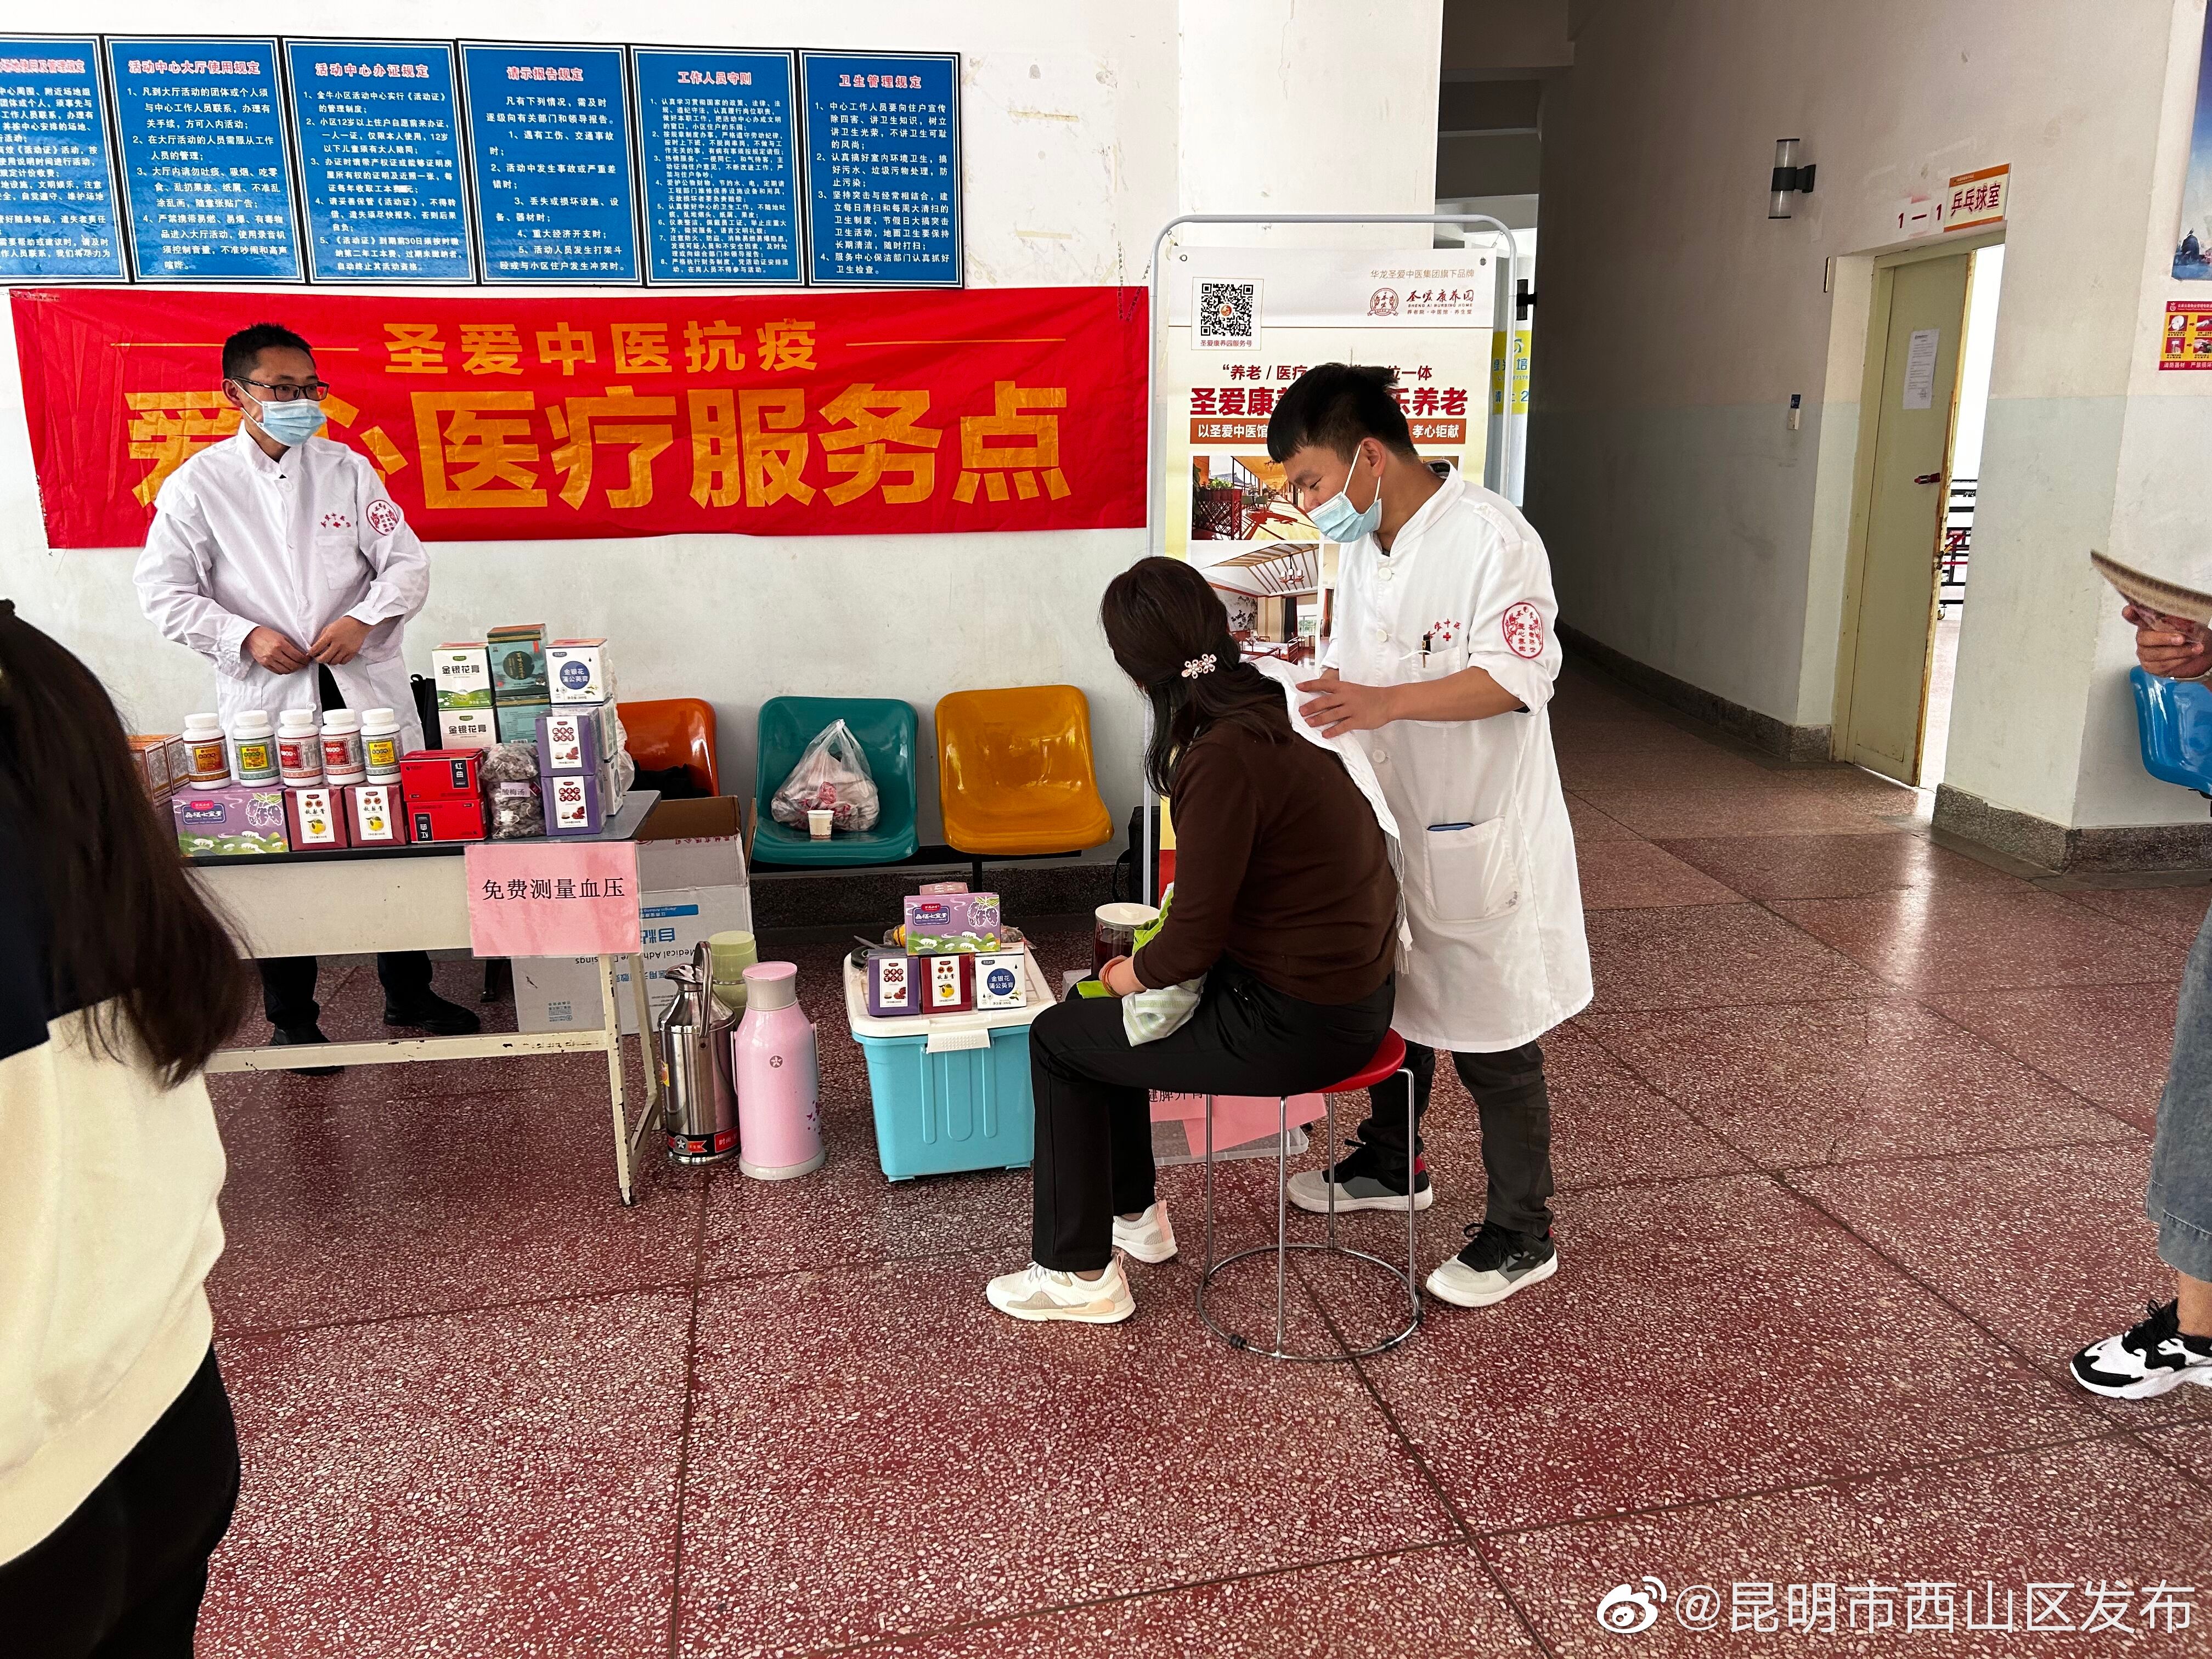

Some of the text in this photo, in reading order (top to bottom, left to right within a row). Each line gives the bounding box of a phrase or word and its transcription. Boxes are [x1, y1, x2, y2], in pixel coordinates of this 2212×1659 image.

[128, 60, 261, 75] 活动中心大厅使用规定
[315, 63, 430, 78] 活动中心办证规定
[506, 66, 584, 81] 请示报告规定
[678, 71, 752, 85] 工作人员守则
[839, 75, 921, 88] 卫生管理规定
[128, 87, 268, 97] 1、凡到大厅活动的团体或个人须
[506, 96, 607, 108] 凡有下列情况，需及时
[815, 101, 946, 113] 1、中心工作人员要向住户宣传
[145, 103, 270, 113] 与中心工作人员联系，办理有
[319, 104, 368, 114] 的管理制度；
[0, 110, 93, 119] 工作人员联系，办理有
[146, 119, 248, 129] 关手续，方可入内活动；
[830, 115, 947, 125] 除四害、讲卫生知识，树立
[831, 128, 947, 138] 讲卫生光荣，不讲卫生可耻
[133, 135, 274, 145] 2、在大厅活动的人员需服从工作
[831, 140, 865, 150] 的风尚；
[151, 151, 204, 161] 人员的管理；
[816, 153, 947, 163] 2、认真搞好室内环境卫生，搞
[832, 178, 866, 187] 止污染；
[818, 191, 947, 200] 3、坚持突击与经常相结合，建
[1951, 183, 2000, 217] 乒乓球室
[834, 204, 949, 213] 立每日清扫和每周大清扫的
[834, 216, 949, 225] 卫生制度，节假日大搞突击
[517, 229, 606, 239] 4、重大经济开支时；
[834, 228, 949, 238] 卫生活动，地面卫生要保持
[518, 245, 622, 255] 5、活动人员发生打架斗
[835, 240, 926, 250] 长期清洁，随时打扫；
[821, 252, 950, 263] 4、服务中心保洁部门认真抓好
[836, 265, 879, 274] 卫生检查。
[1370, 269, 1474, 279] 华龙圣爱中医集团旗下品牌
[384, 319, 817, 376] 圣爱中医抗疫
[1190, 387, 1288, 416] 圣爱康
[1198, 424, 1459, 438] 以圣爱中医馆 孝心钜献
[442, 665, 479, 674] 金银花膏
[449, 725, 486, 733] 金银花膏
[482, 878, 625, 900] 免费测量血压
